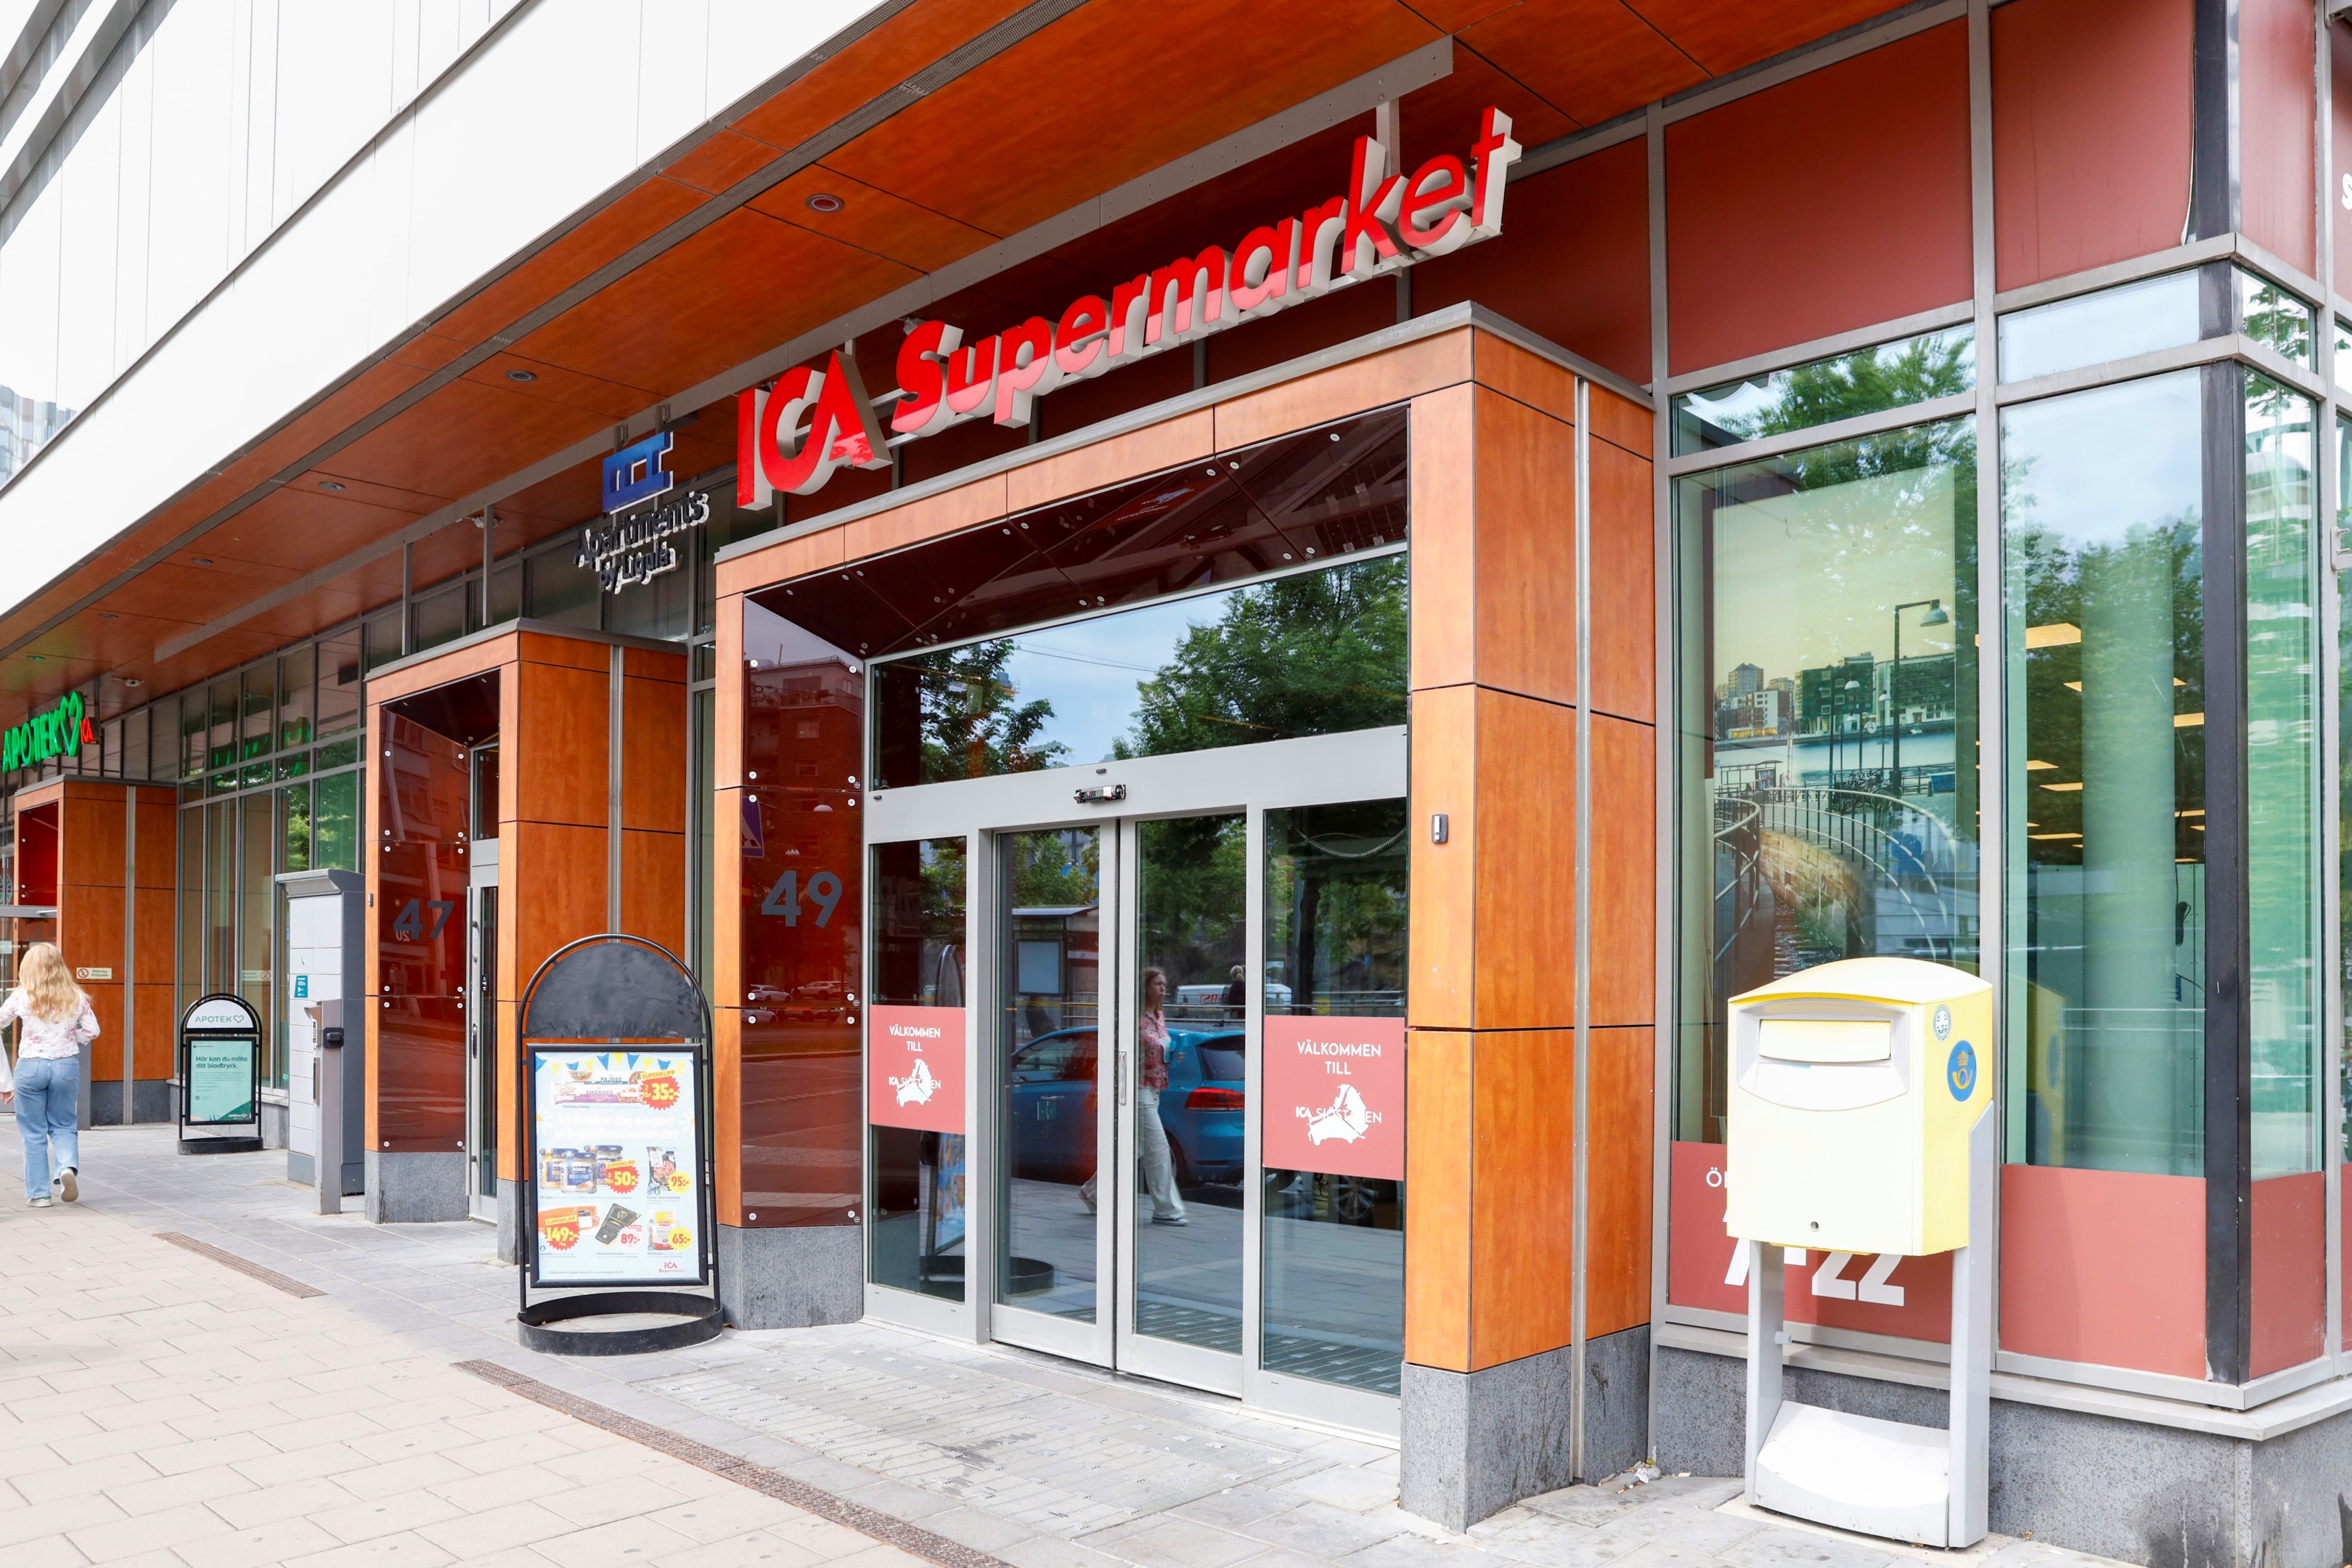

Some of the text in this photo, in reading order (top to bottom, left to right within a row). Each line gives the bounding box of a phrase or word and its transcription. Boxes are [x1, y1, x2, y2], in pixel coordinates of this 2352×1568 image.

[737, 105, 1522, 510] ICA Supermarket
[573, 491, 710, 571] Apartments
[600, 542, 676, 594] by Ligula
[2, 707, 62, 774] APOTEK
[761, 870, 843, 928] 49
[393, 899, 455, 940] 47
[889, 1024, 941, 1038] VÄLKOMMEN
[906, 1041, 923, 1051] TILL
[1297, 1040, 1381, 1057] VÄLKOMMEN
[642, 1070, 675, 1079] SUPERKLIPP
[1325, 1061, 1351, 1074] TILL
[889, 1076, 899, 1085] ICA
[652, 1082, 679, 1101] 35:-
[1295, 1106, 1311, 1118] ICA
[614, 1171, 639, 1186] 50:-
[671, 1176, 689, 1186] 95:-
[546, 1227, 579, 1241] 149:-
[621, 1233, 640, 1244] 89:-
[672, 1233, 690, 1244] 65:-
